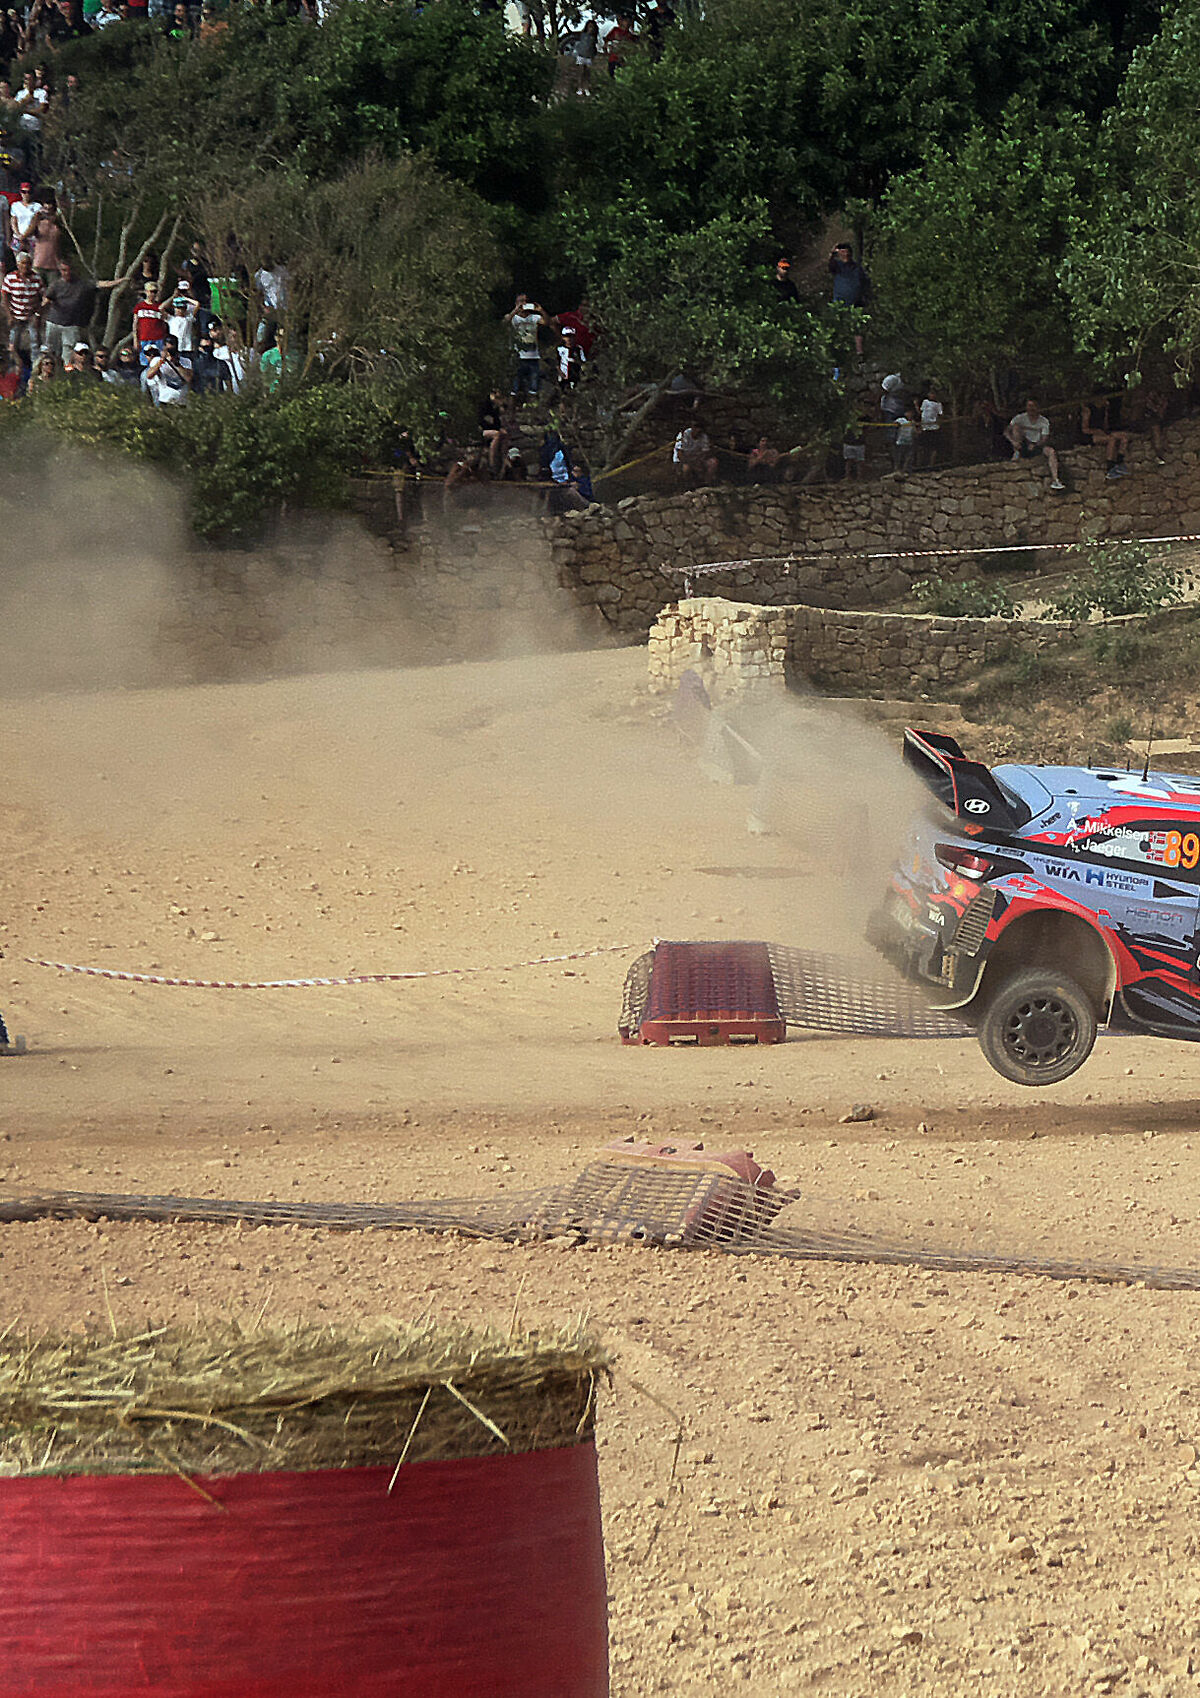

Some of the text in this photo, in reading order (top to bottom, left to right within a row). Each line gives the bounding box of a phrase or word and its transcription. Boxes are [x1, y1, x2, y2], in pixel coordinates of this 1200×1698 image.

[1085, 820, 1150, 842] Mikkelsen
[1081, 838, 1127, 857] Jaeger
[1163, 830, 1200, 869] 89
[1106, 872, 1149, 886] HYUNDAI
[1106, 880, 1137, 892] STEEL
